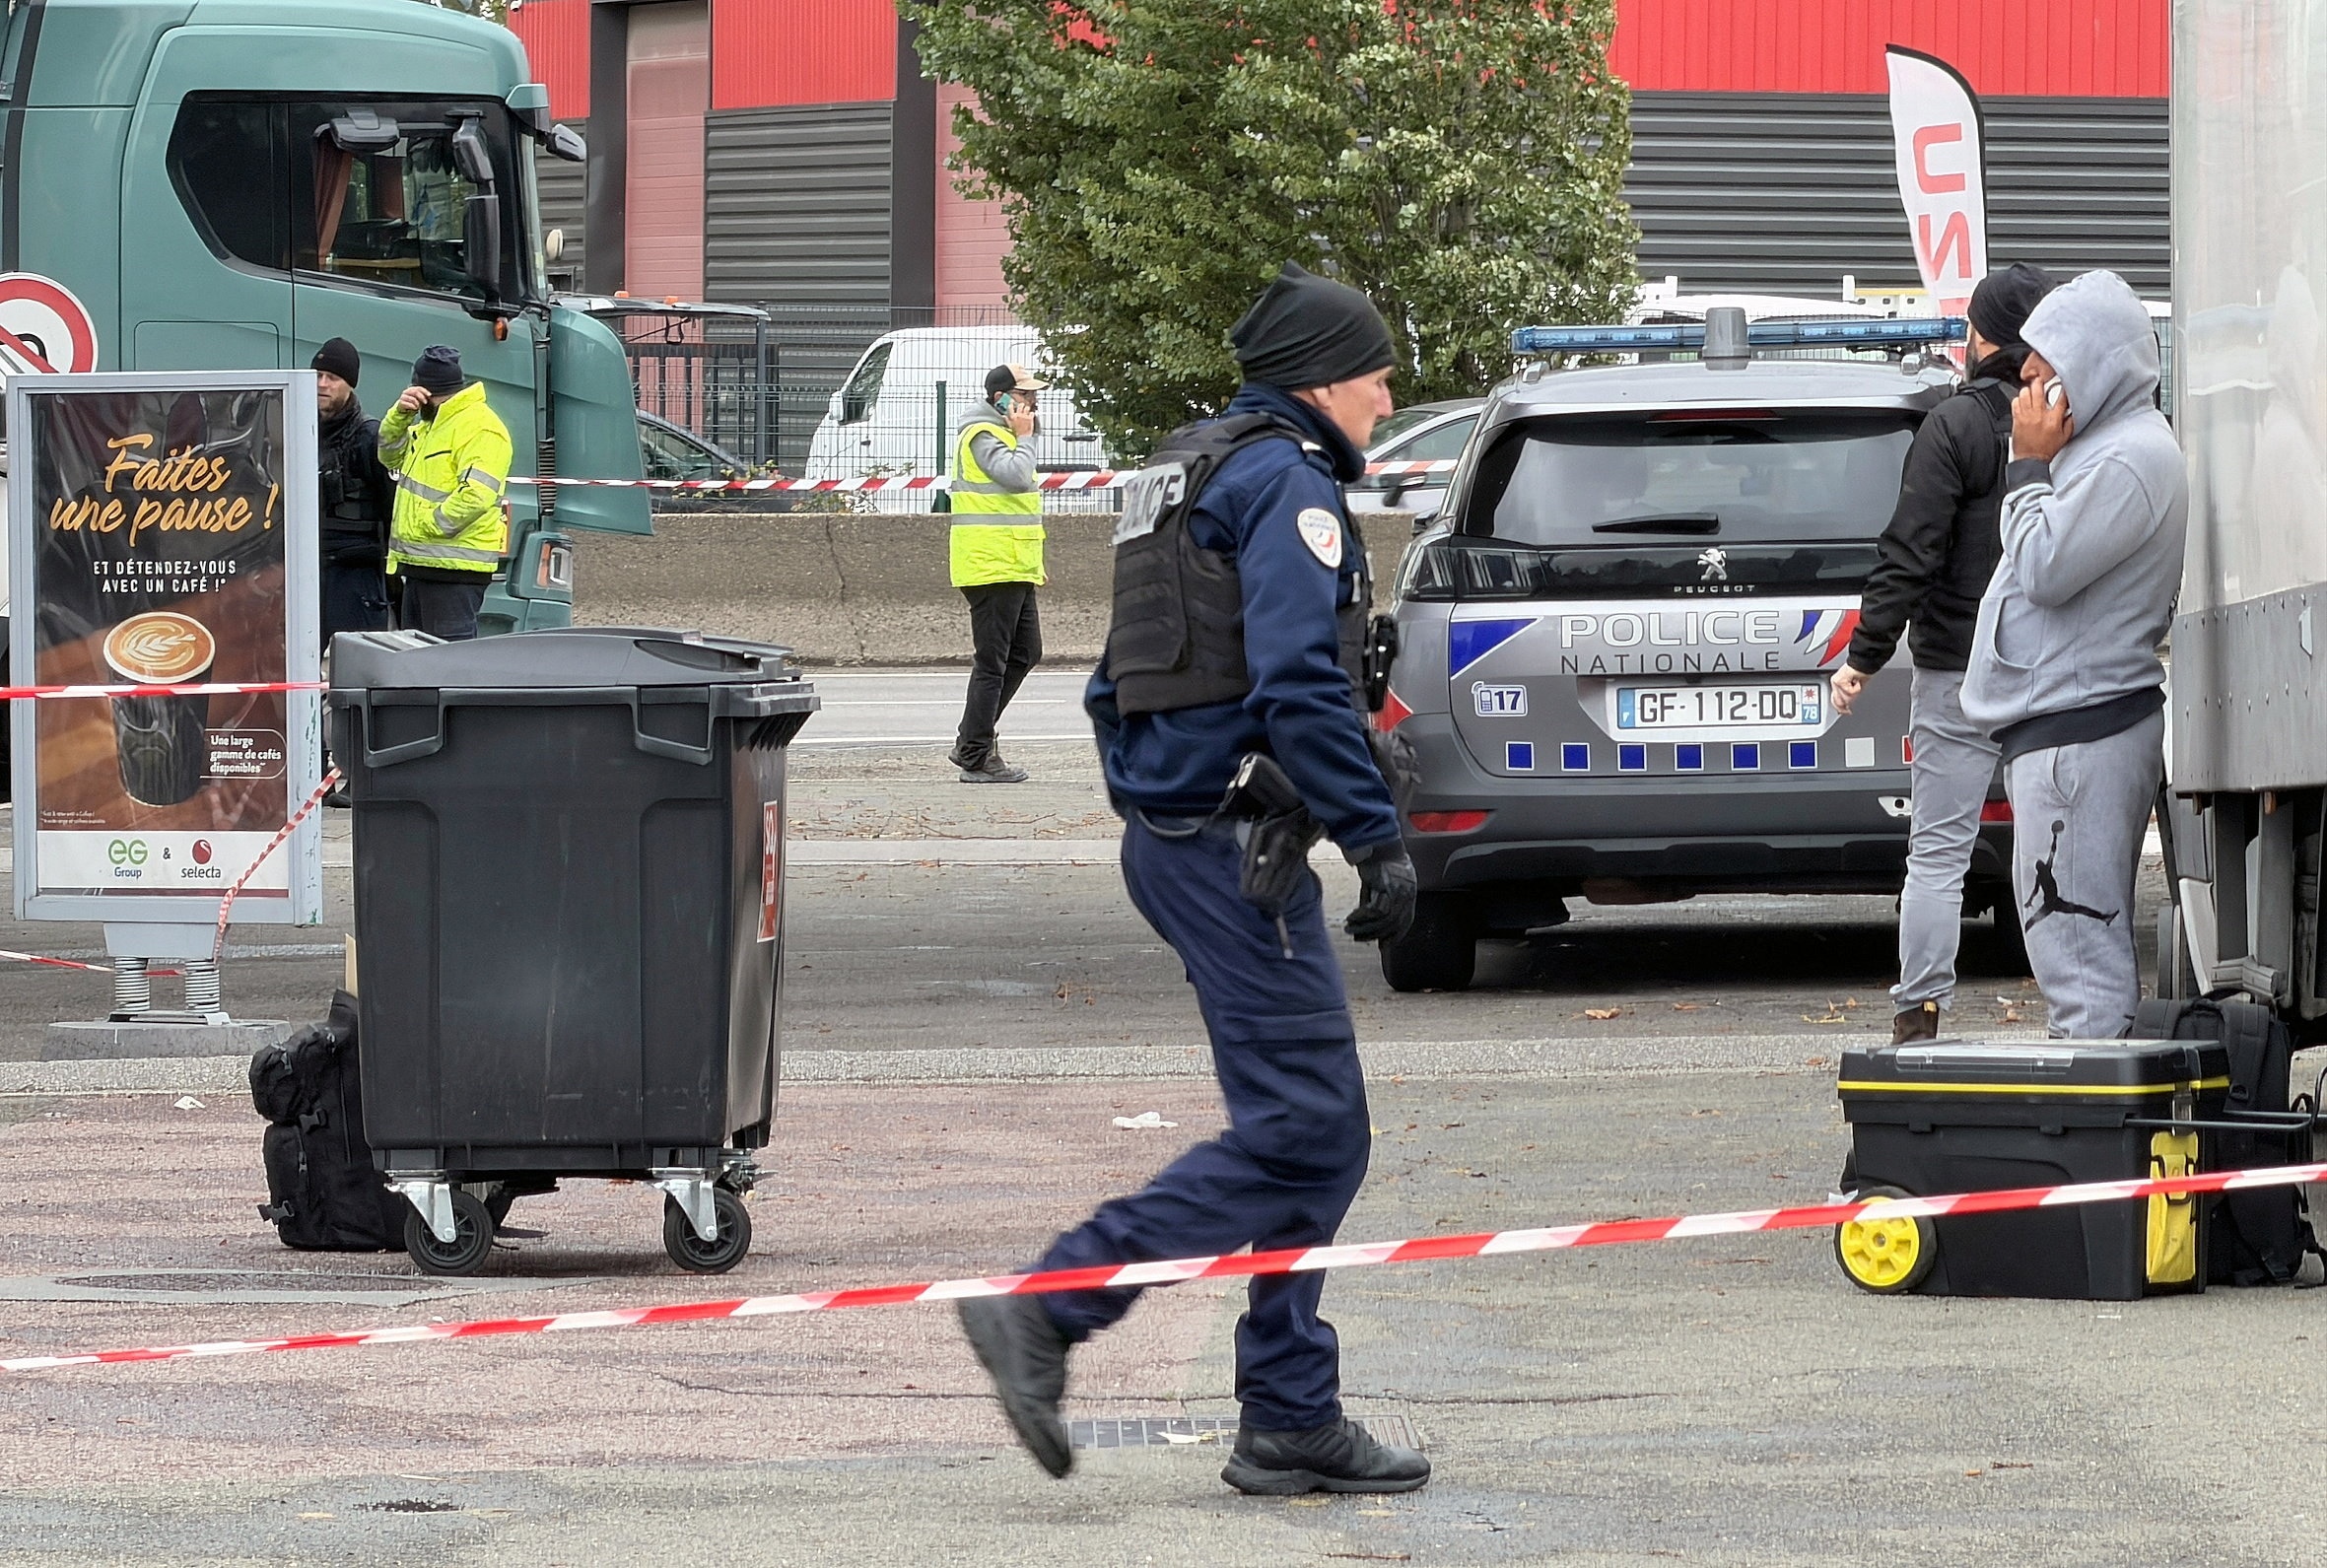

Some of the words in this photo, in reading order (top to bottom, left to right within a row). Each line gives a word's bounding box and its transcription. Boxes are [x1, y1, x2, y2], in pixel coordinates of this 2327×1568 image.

[104, 433, 233, 493] Faites
[49, 495, 127, 533] une
[128, 496, 253, 548] pause
[262, 482, 280, 530] !
[94, 561, 108, 575] ET
[116, 558, 237, 575] DÉTENDEZ-VOUS
[102, 579, 138, 593] AVEC
[145, 579, 165, 593] UN
[171, 576, 208, 593] CAFÉ
[1674, 583, 1756, 594] PEUGEOT
[1560, 609, 1780, 648] POLICE
[1561, 650, 1780, 674] NATIONALE
[1494, 691, 1521, 711] 17
[1803, 705, 1817, 720] 78
[210, 734, 230, 746] Une
[230, 734, 254, 749] large
[210, 750, 243, 762] gamme
[243, 748, 256, 759] de
[162, 847, 171, 860] &
[113, 866, 143, 879] Group
[180, 865, 222, 879] selecta
